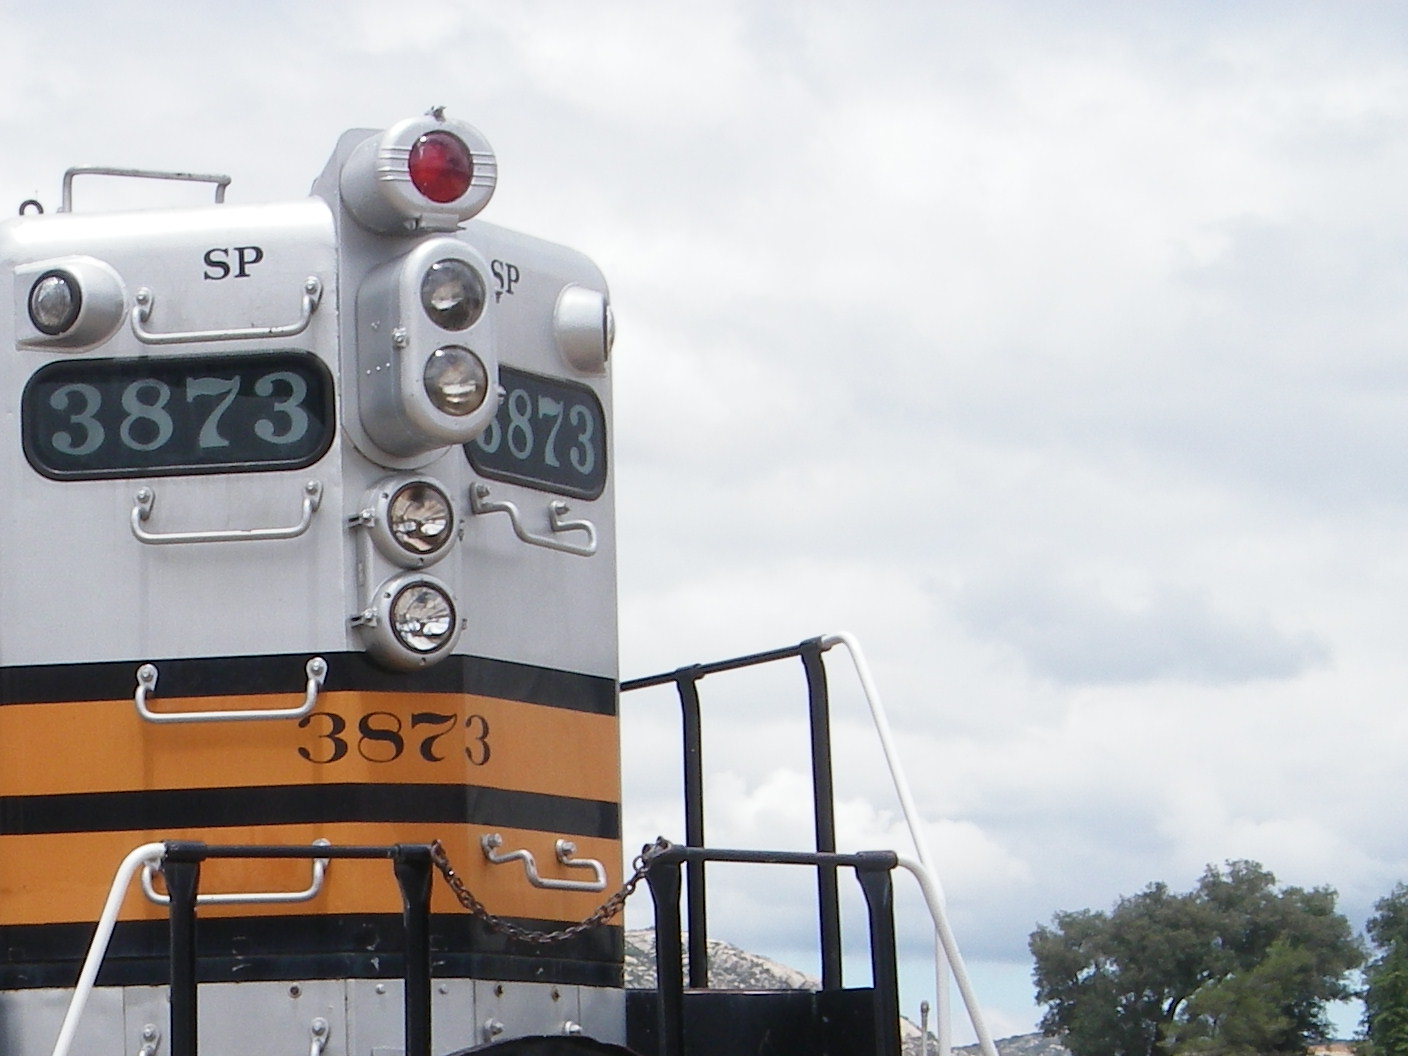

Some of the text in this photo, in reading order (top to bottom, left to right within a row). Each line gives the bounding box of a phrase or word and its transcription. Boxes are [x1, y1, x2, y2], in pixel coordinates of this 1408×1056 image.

[203, 245, 264, 281] SP
[490, 259, 520, 295] SP
[49, 370, 310, 456] 3873
[296, 711, 492, 766] 3873
